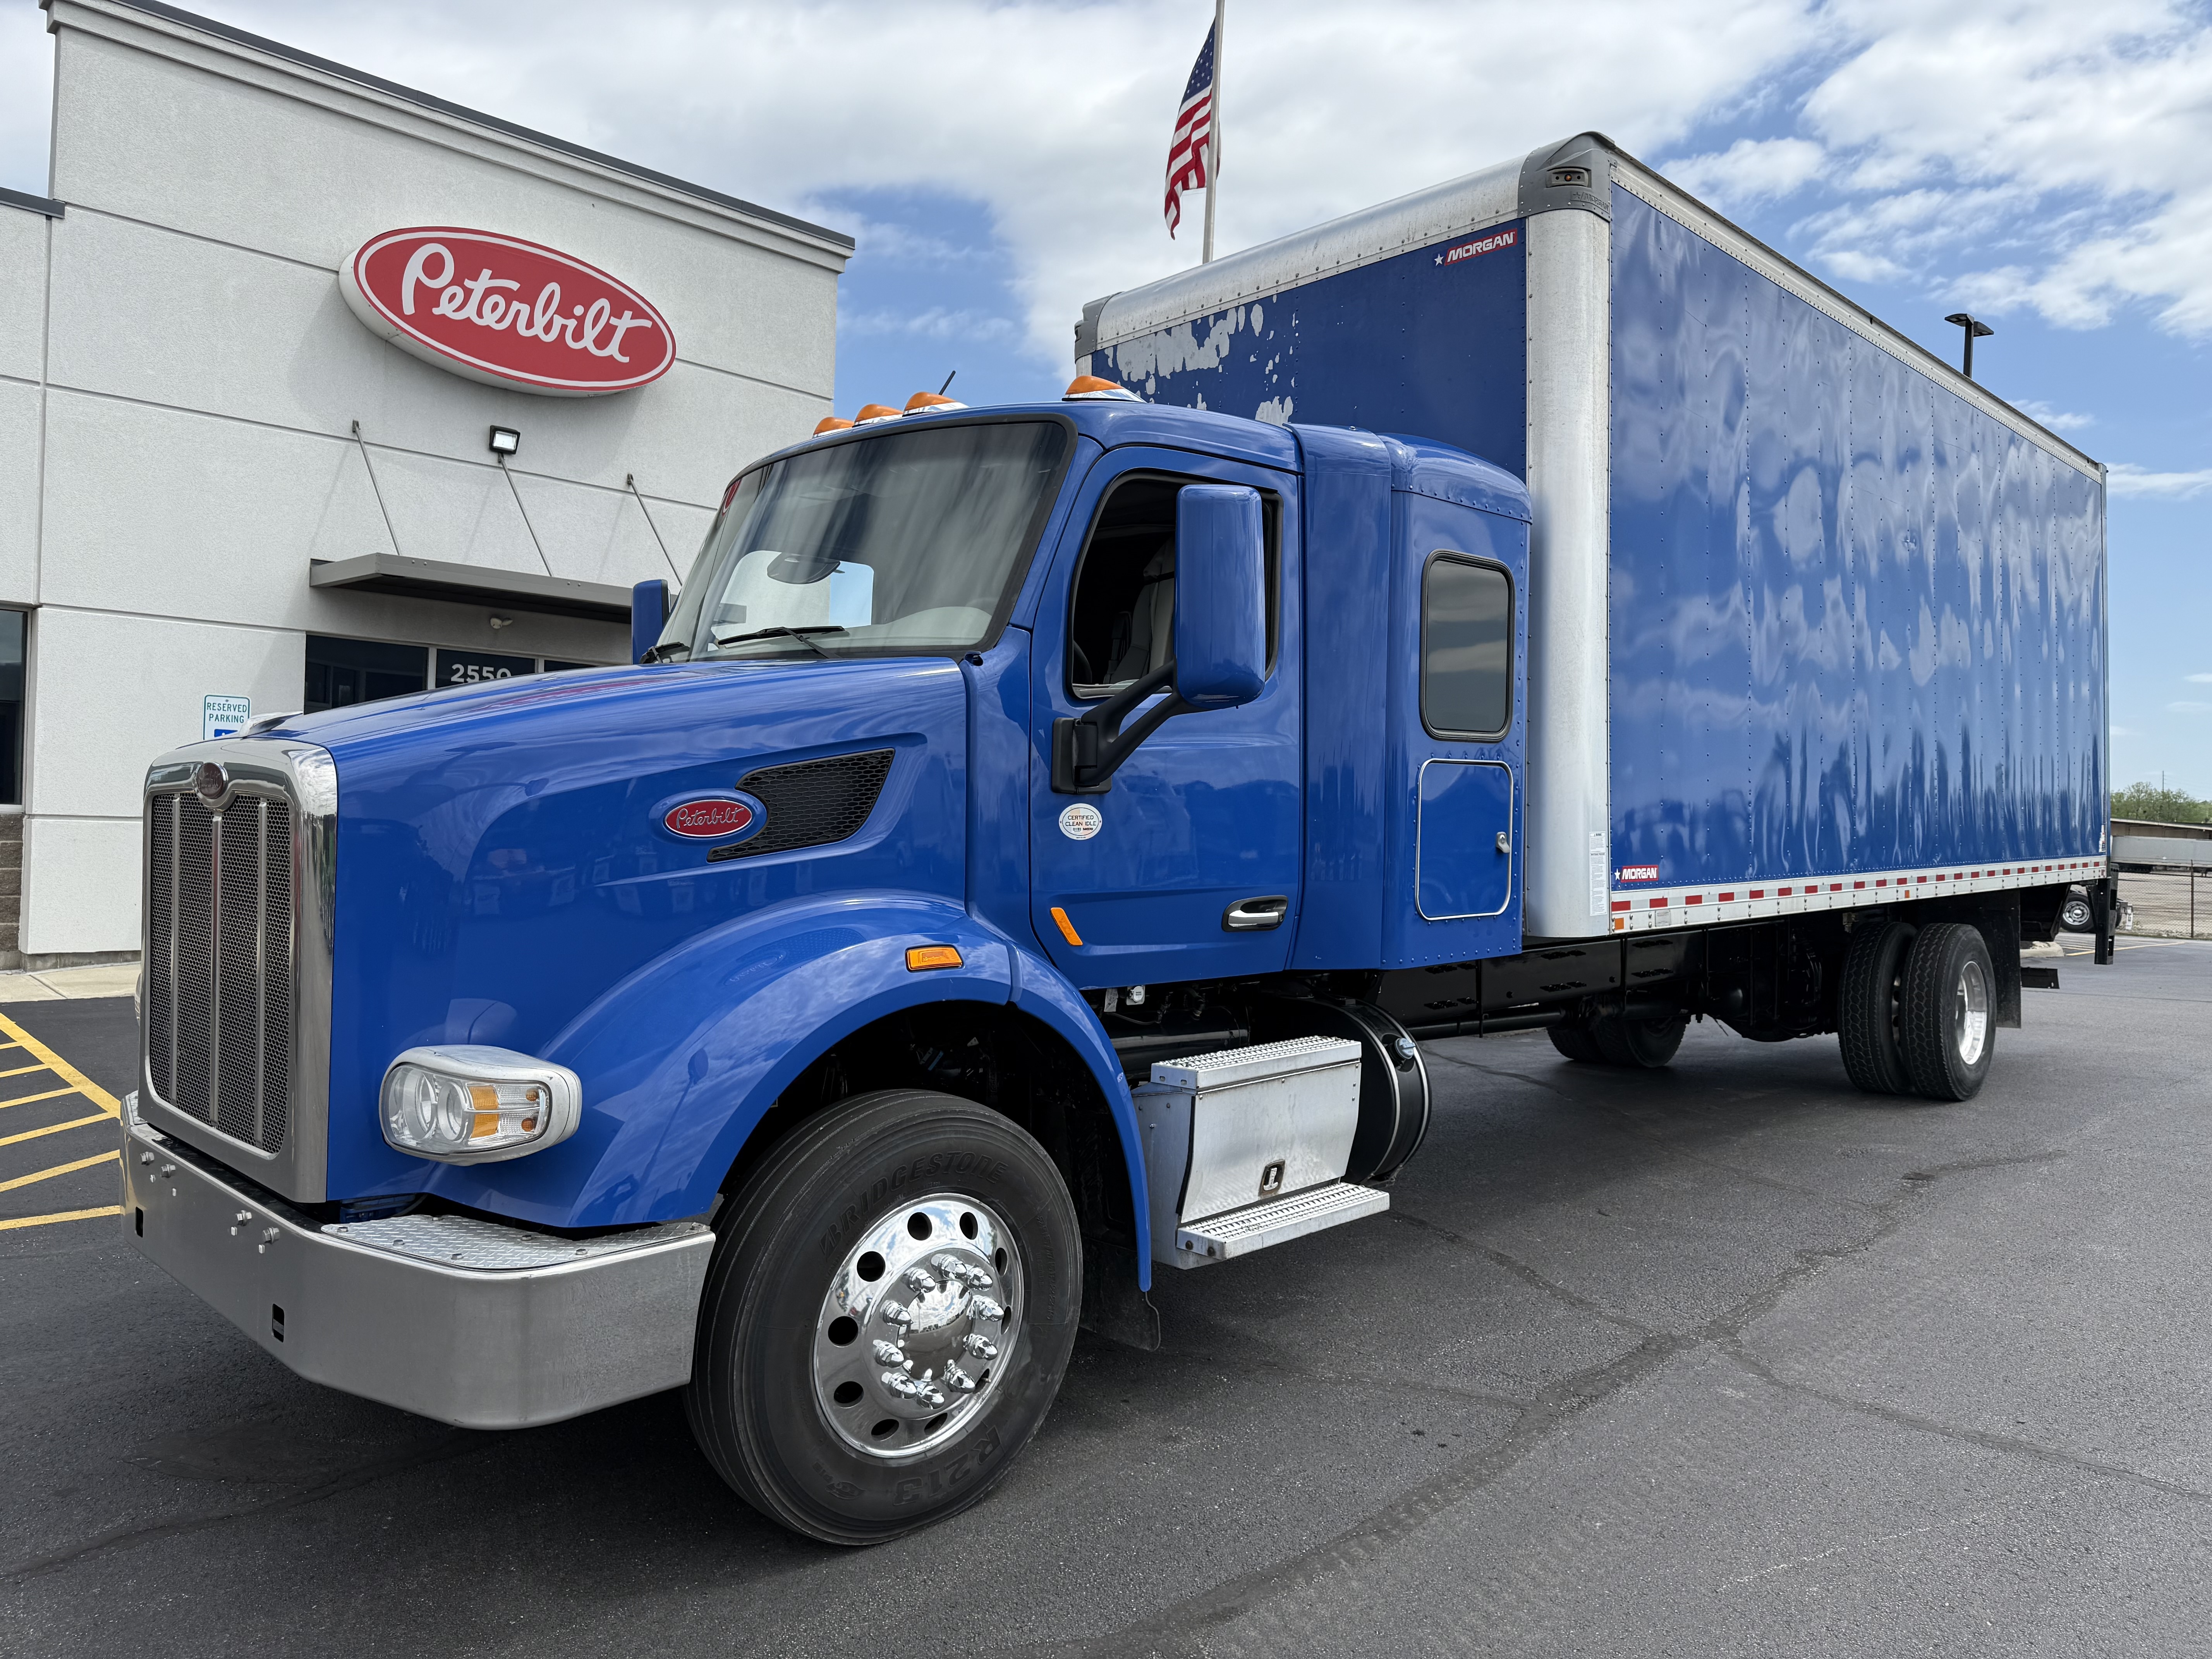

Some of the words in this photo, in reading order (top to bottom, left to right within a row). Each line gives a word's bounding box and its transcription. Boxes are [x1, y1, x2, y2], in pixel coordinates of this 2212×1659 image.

[1447, 232, 1514, 263] MORGAN
[402, 243, 653, 363] Peterbilt
[451, 663, 512, 683] 2550
[207, 702, 247, 713] RESERVED
[209, 714, 244, 723] PARKING
[676, 808, 744, 829] Peterbilt
[1622, 867, 1657, 880] MORGAN
[819, 1151, 1009, 1258] BRIDGESTONE
[892, 1425, 1002, 1506] R213
